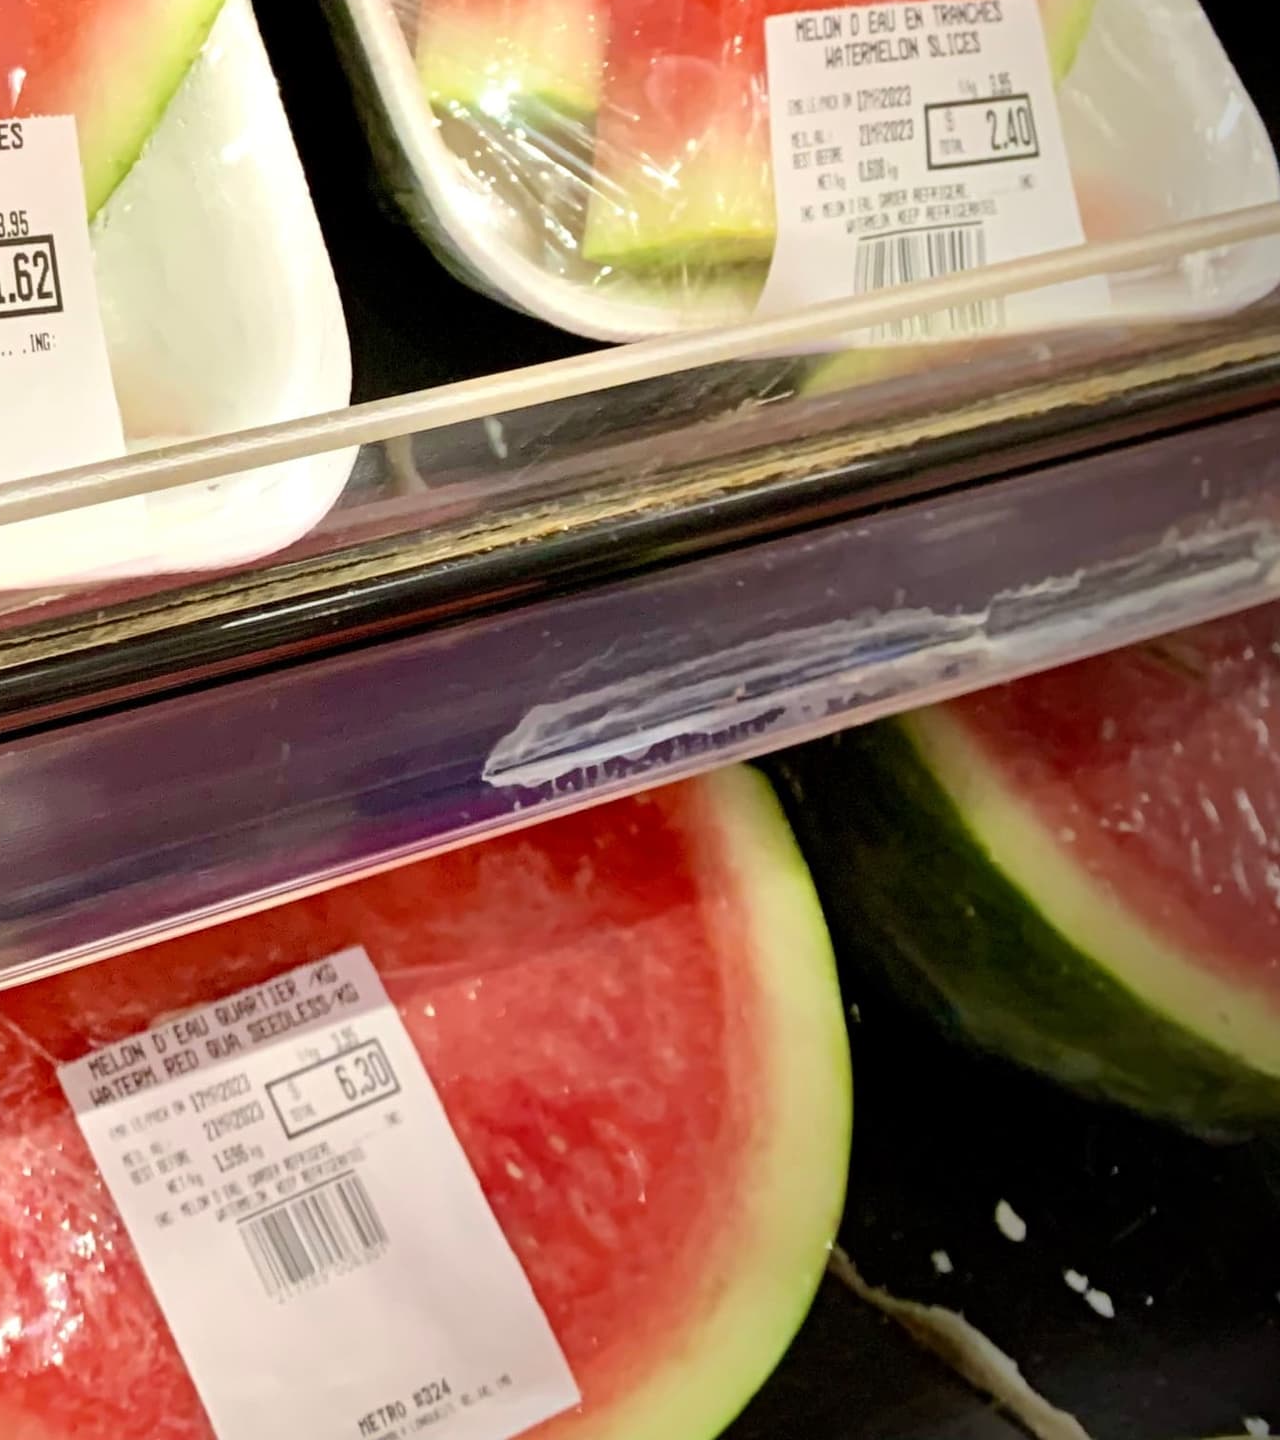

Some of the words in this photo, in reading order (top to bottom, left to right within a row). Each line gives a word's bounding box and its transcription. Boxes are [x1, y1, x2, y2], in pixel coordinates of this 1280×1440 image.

[796, 17, 842, 42] MELON
[868, 9, 896, 35] EAU
[825, 38, 920, 69] WATERMELON
[927, 31, 982, 59] SLICES
[985, 105, 1032, 151] 2.40
[89, 1040, 146, 1081] MELON
[151, 1011, 211, 1053] D'EAU
[214, 980, 298, 1027] QUARTIER
[89, 1068, 158, 1108] WATERM
[162, 1047, 200, 1078] RED
[205, 1031, 244, 1059] QUA
[334, 1049, 390, 1103] 6.30
[357, 1400, 407, 1438] METRO
